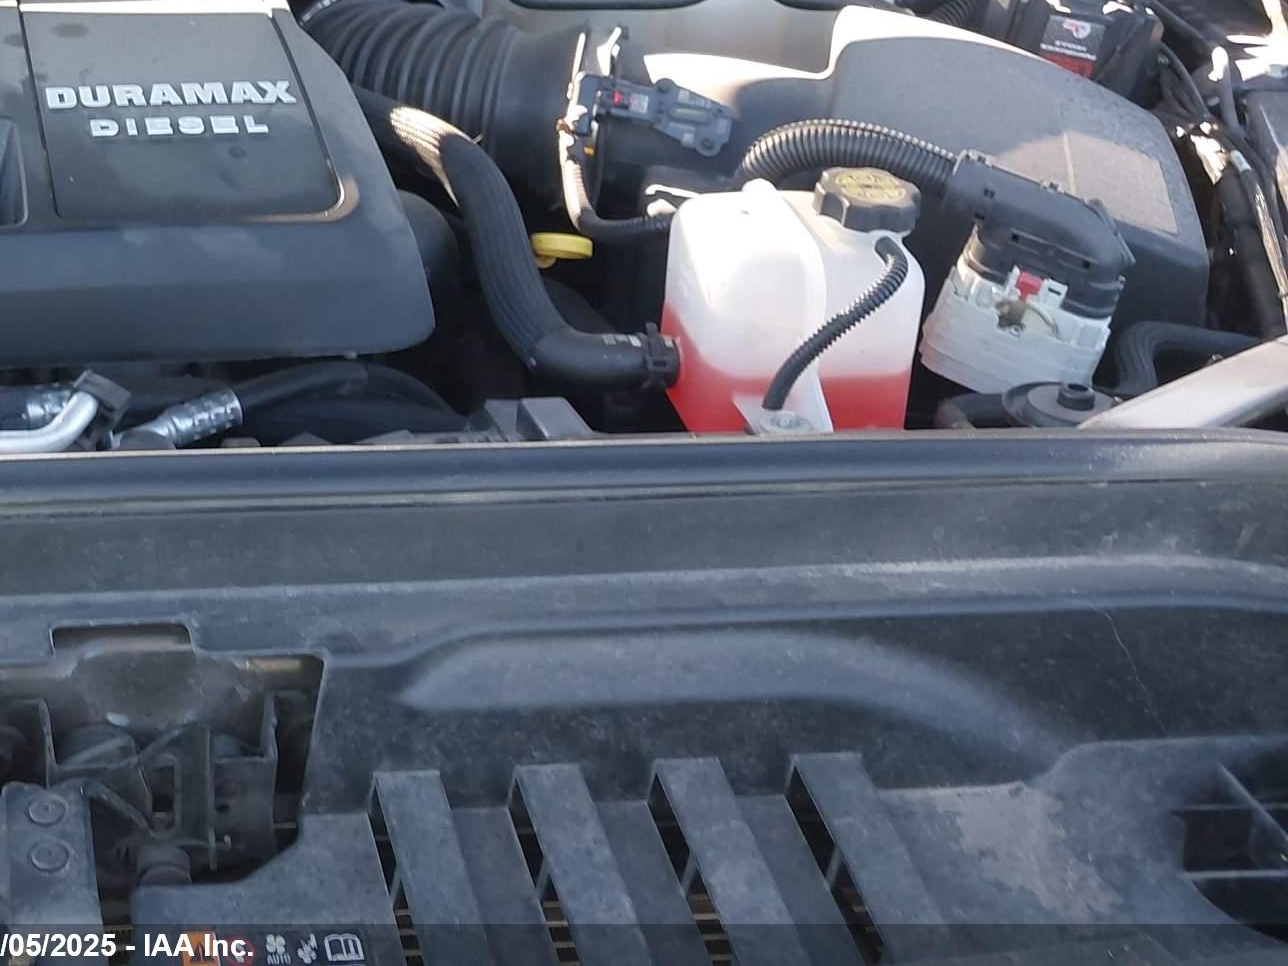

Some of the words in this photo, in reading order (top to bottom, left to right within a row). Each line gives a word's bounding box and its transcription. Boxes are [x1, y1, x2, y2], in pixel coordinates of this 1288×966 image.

[45, 80, 297, 109] DURAMAX
[89, 115, 269, 136] DIESEL
[267, 953, 292, 965] AUTO
